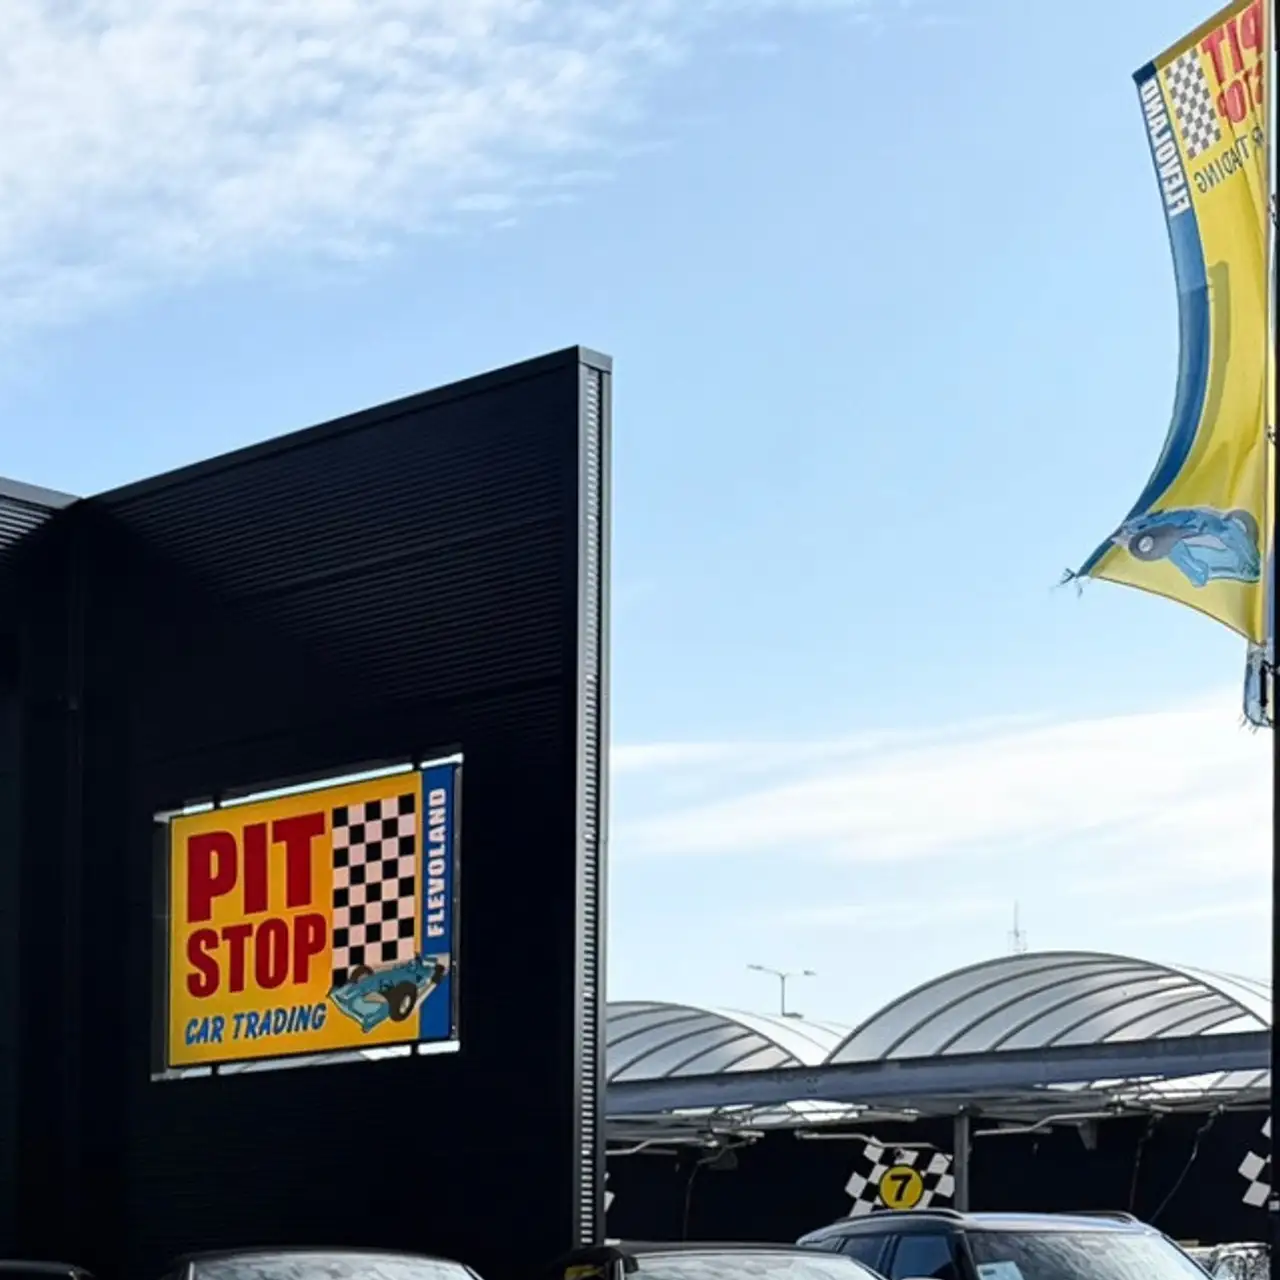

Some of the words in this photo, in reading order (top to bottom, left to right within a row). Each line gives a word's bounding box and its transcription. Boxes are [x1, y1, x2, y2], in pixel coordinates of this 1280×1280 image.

[187, 811, 326, 924] PIT
[427, 788, 447, 938] FLEVOLAND
[186, 912, 327, 999] STOP
[184, 1015, 226, 1047] CAR
[232, 1002, 328, 1040] TRADING
[890, 1174, 913, 1201] 7
